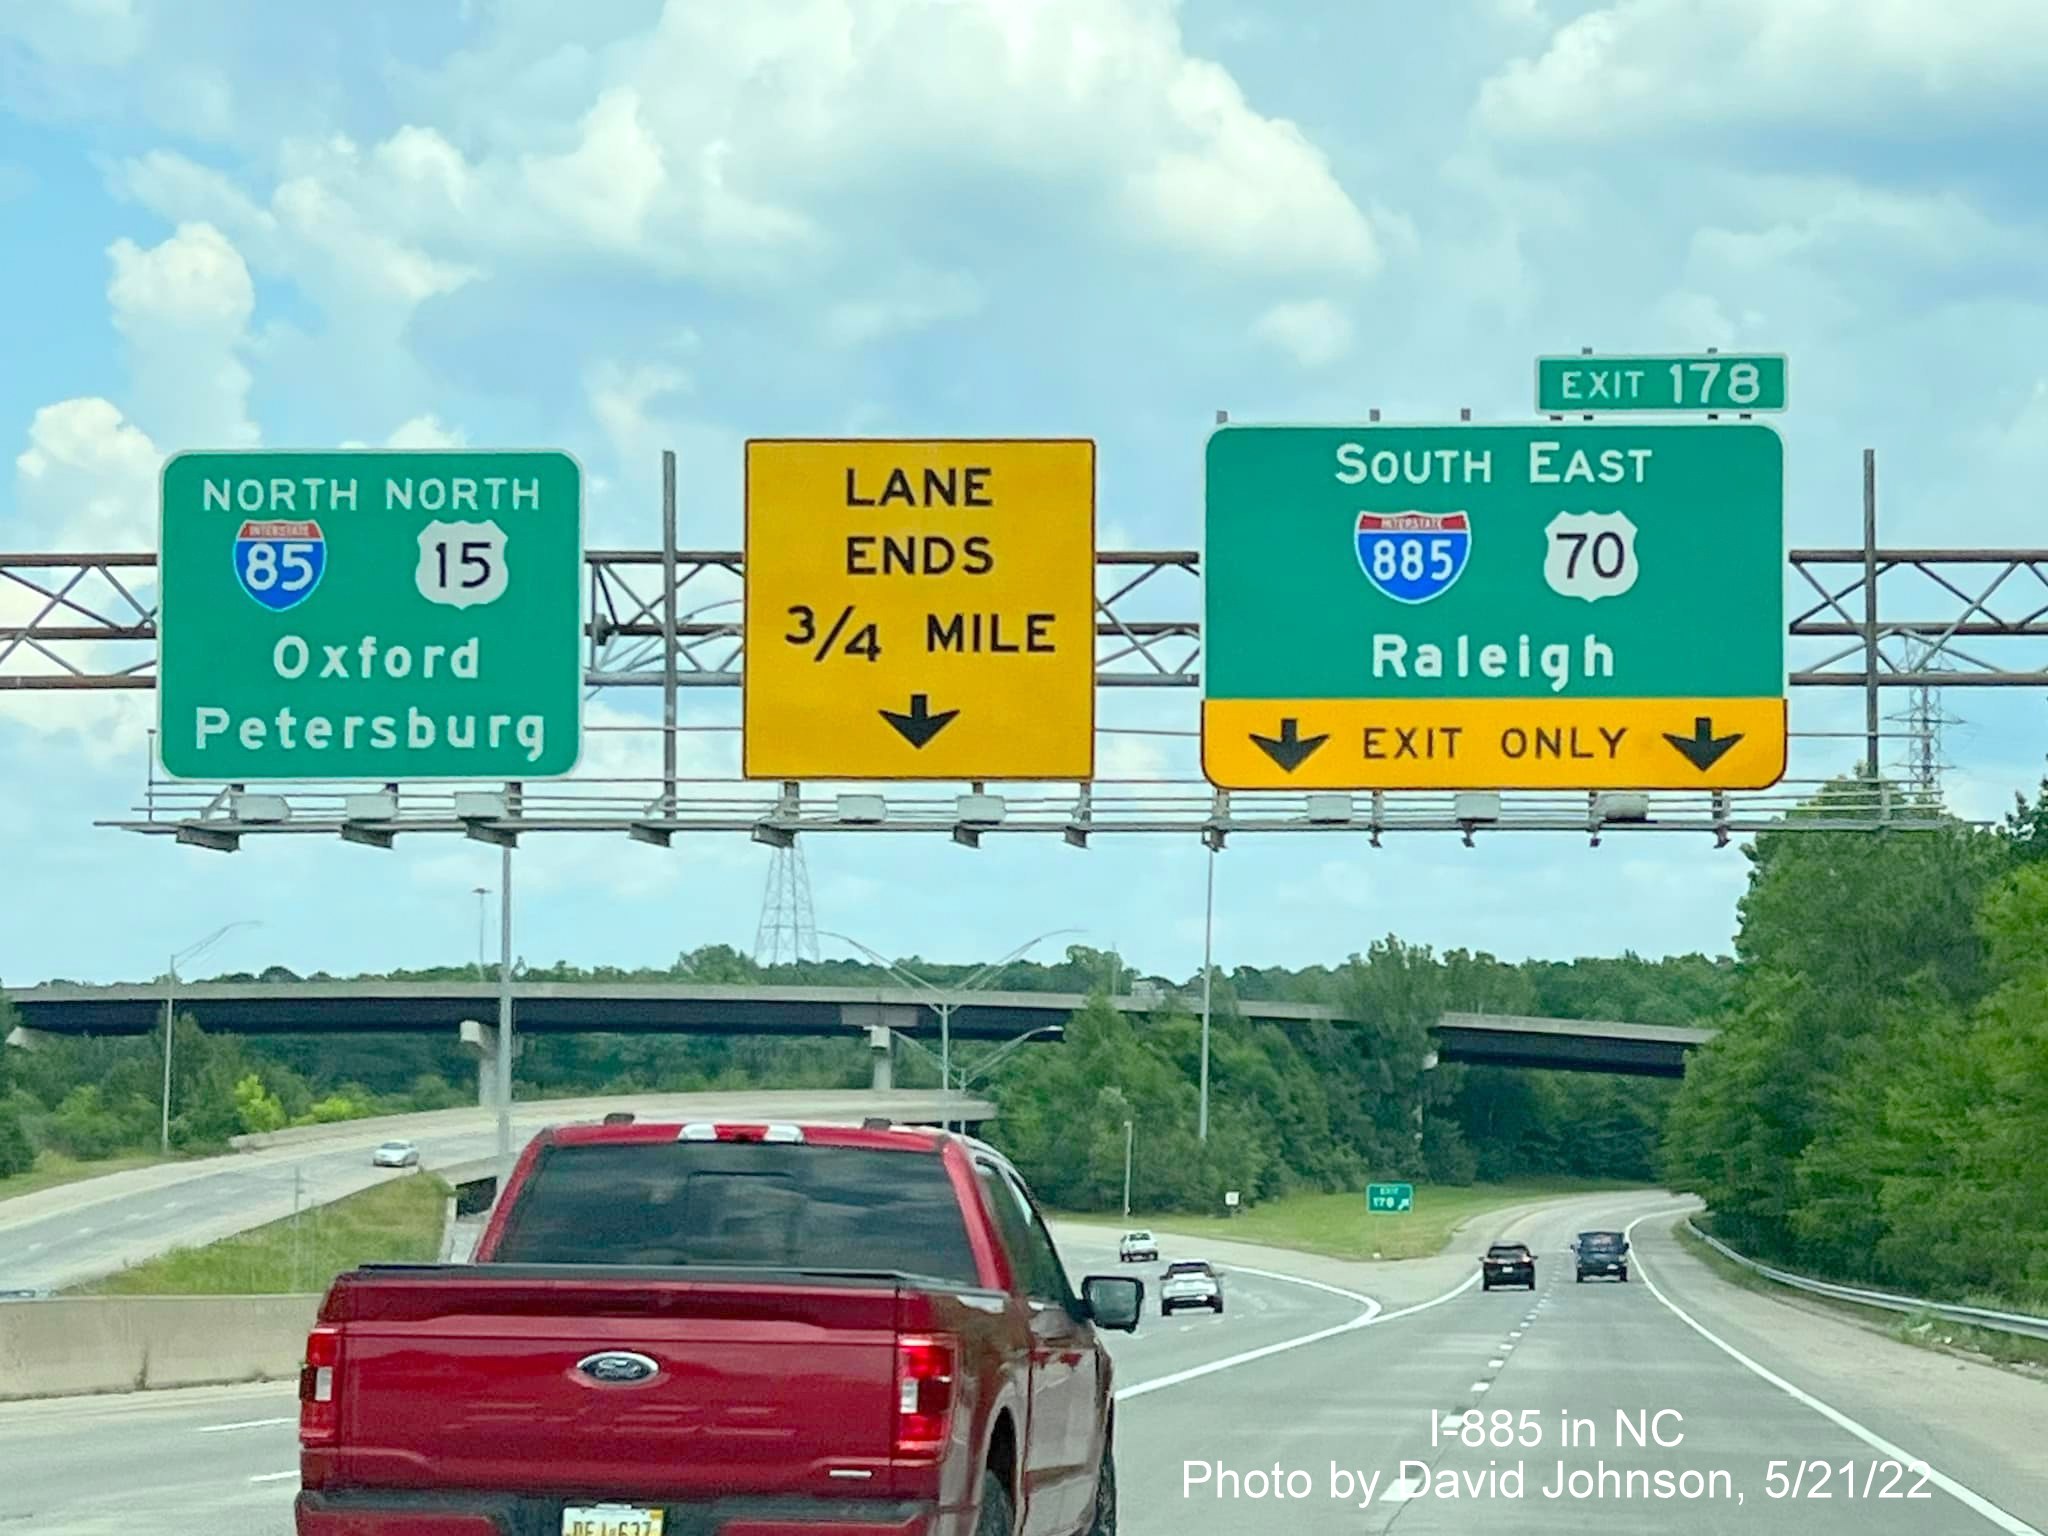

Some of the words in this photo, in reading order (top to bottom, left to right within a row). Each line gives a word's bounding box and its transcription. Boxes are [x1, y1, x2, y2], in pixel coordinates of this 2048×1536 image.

[1563, 371, 1643, 399] EXIT
[1670, 363, 1760, 405] 178
[1335, 443, 1492, 484] SOUTH
[1530, 442, 1653, 483] EAST
[203, 478, 358, 511] NORTH
[386, 478, 540, 511] NORTH
[846, 467, 993, 507] LANE
[246, 543, 313, 591] 85
[435, 541, 492, 588] 15
[847, 536, 994, 575] ENDS
[1373, 539, 1453, 581] 885
[1556, 531, 1626, 579] 70
[785, 605, 882, 662] 3/4
[927, 613, 1056, 653] MILE
[273, 635, 480, 679] Oxford
[1373, 633, 1614, 692] Raleigh
[196, 706, 545, 762] Petersburg
[1363, 728, 1463, 760] EXIT
[1500, 727, 1628, 759] ONLY
